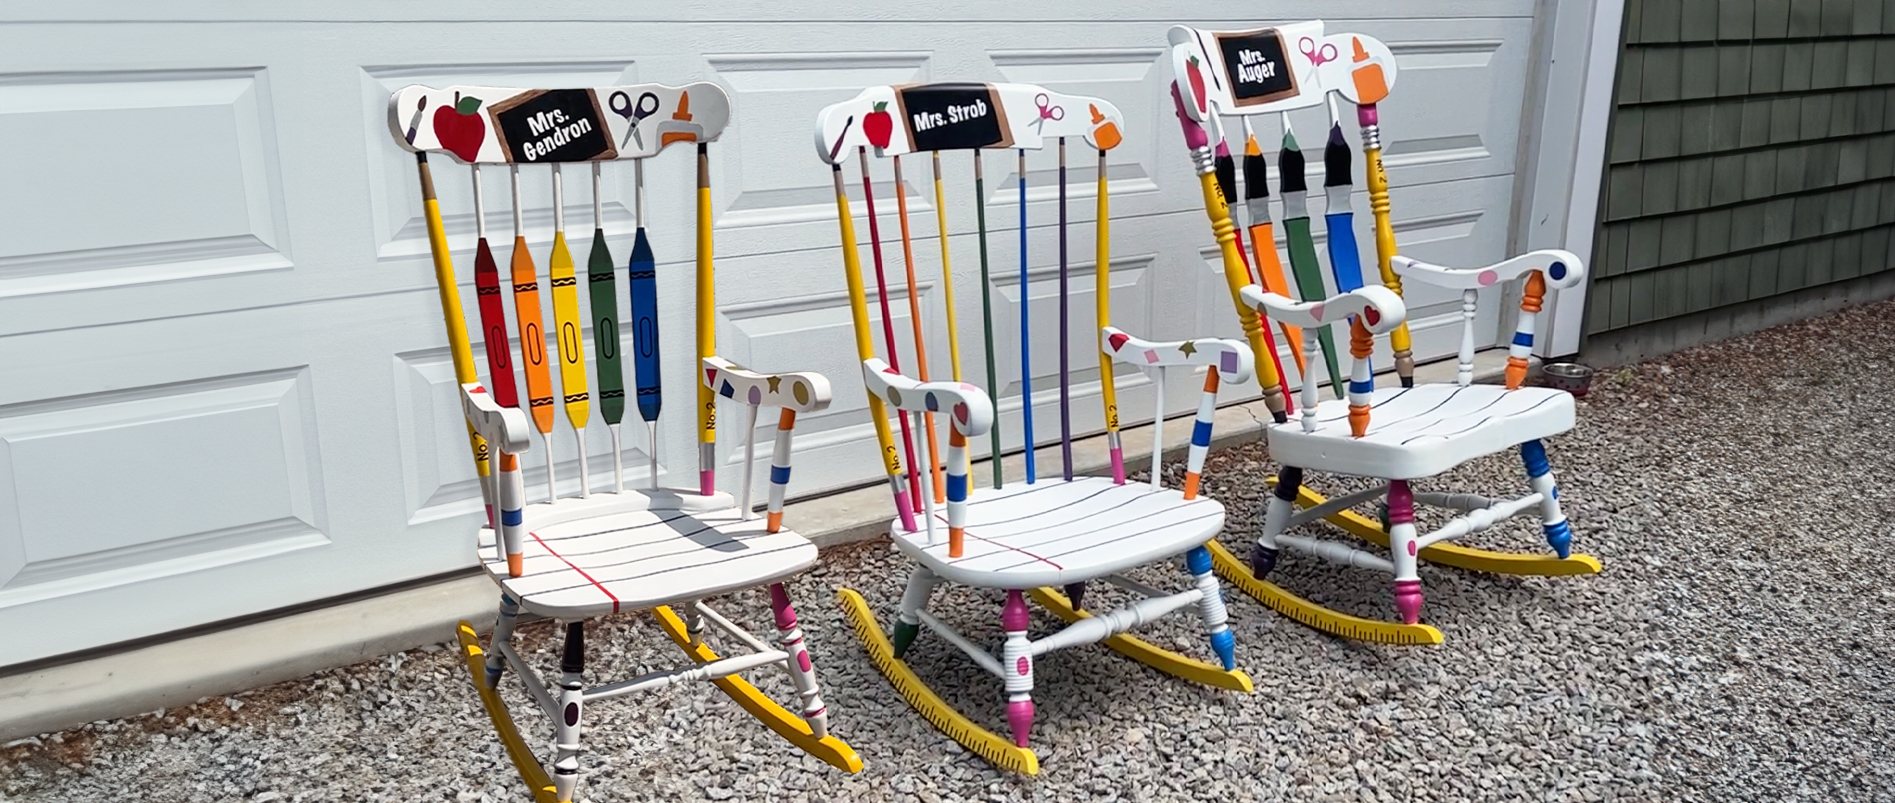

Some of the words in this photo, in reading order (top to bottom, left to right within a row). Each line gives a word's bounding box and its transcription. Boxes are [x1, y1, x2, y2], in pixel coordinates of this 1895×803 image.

[1238, 49, 1266, 66] Mrs.
[1237, 61, 1275, 83] Auger
[526, 108, 570, 137] Mrs.
[913, 111, 947, 132] Mrs.
[947, 98, 987, 123] Strob
[523, 117, 592, 161] Gendron
[706, 402, 716, 410] 2
[886, 444, 896, 453] 2
